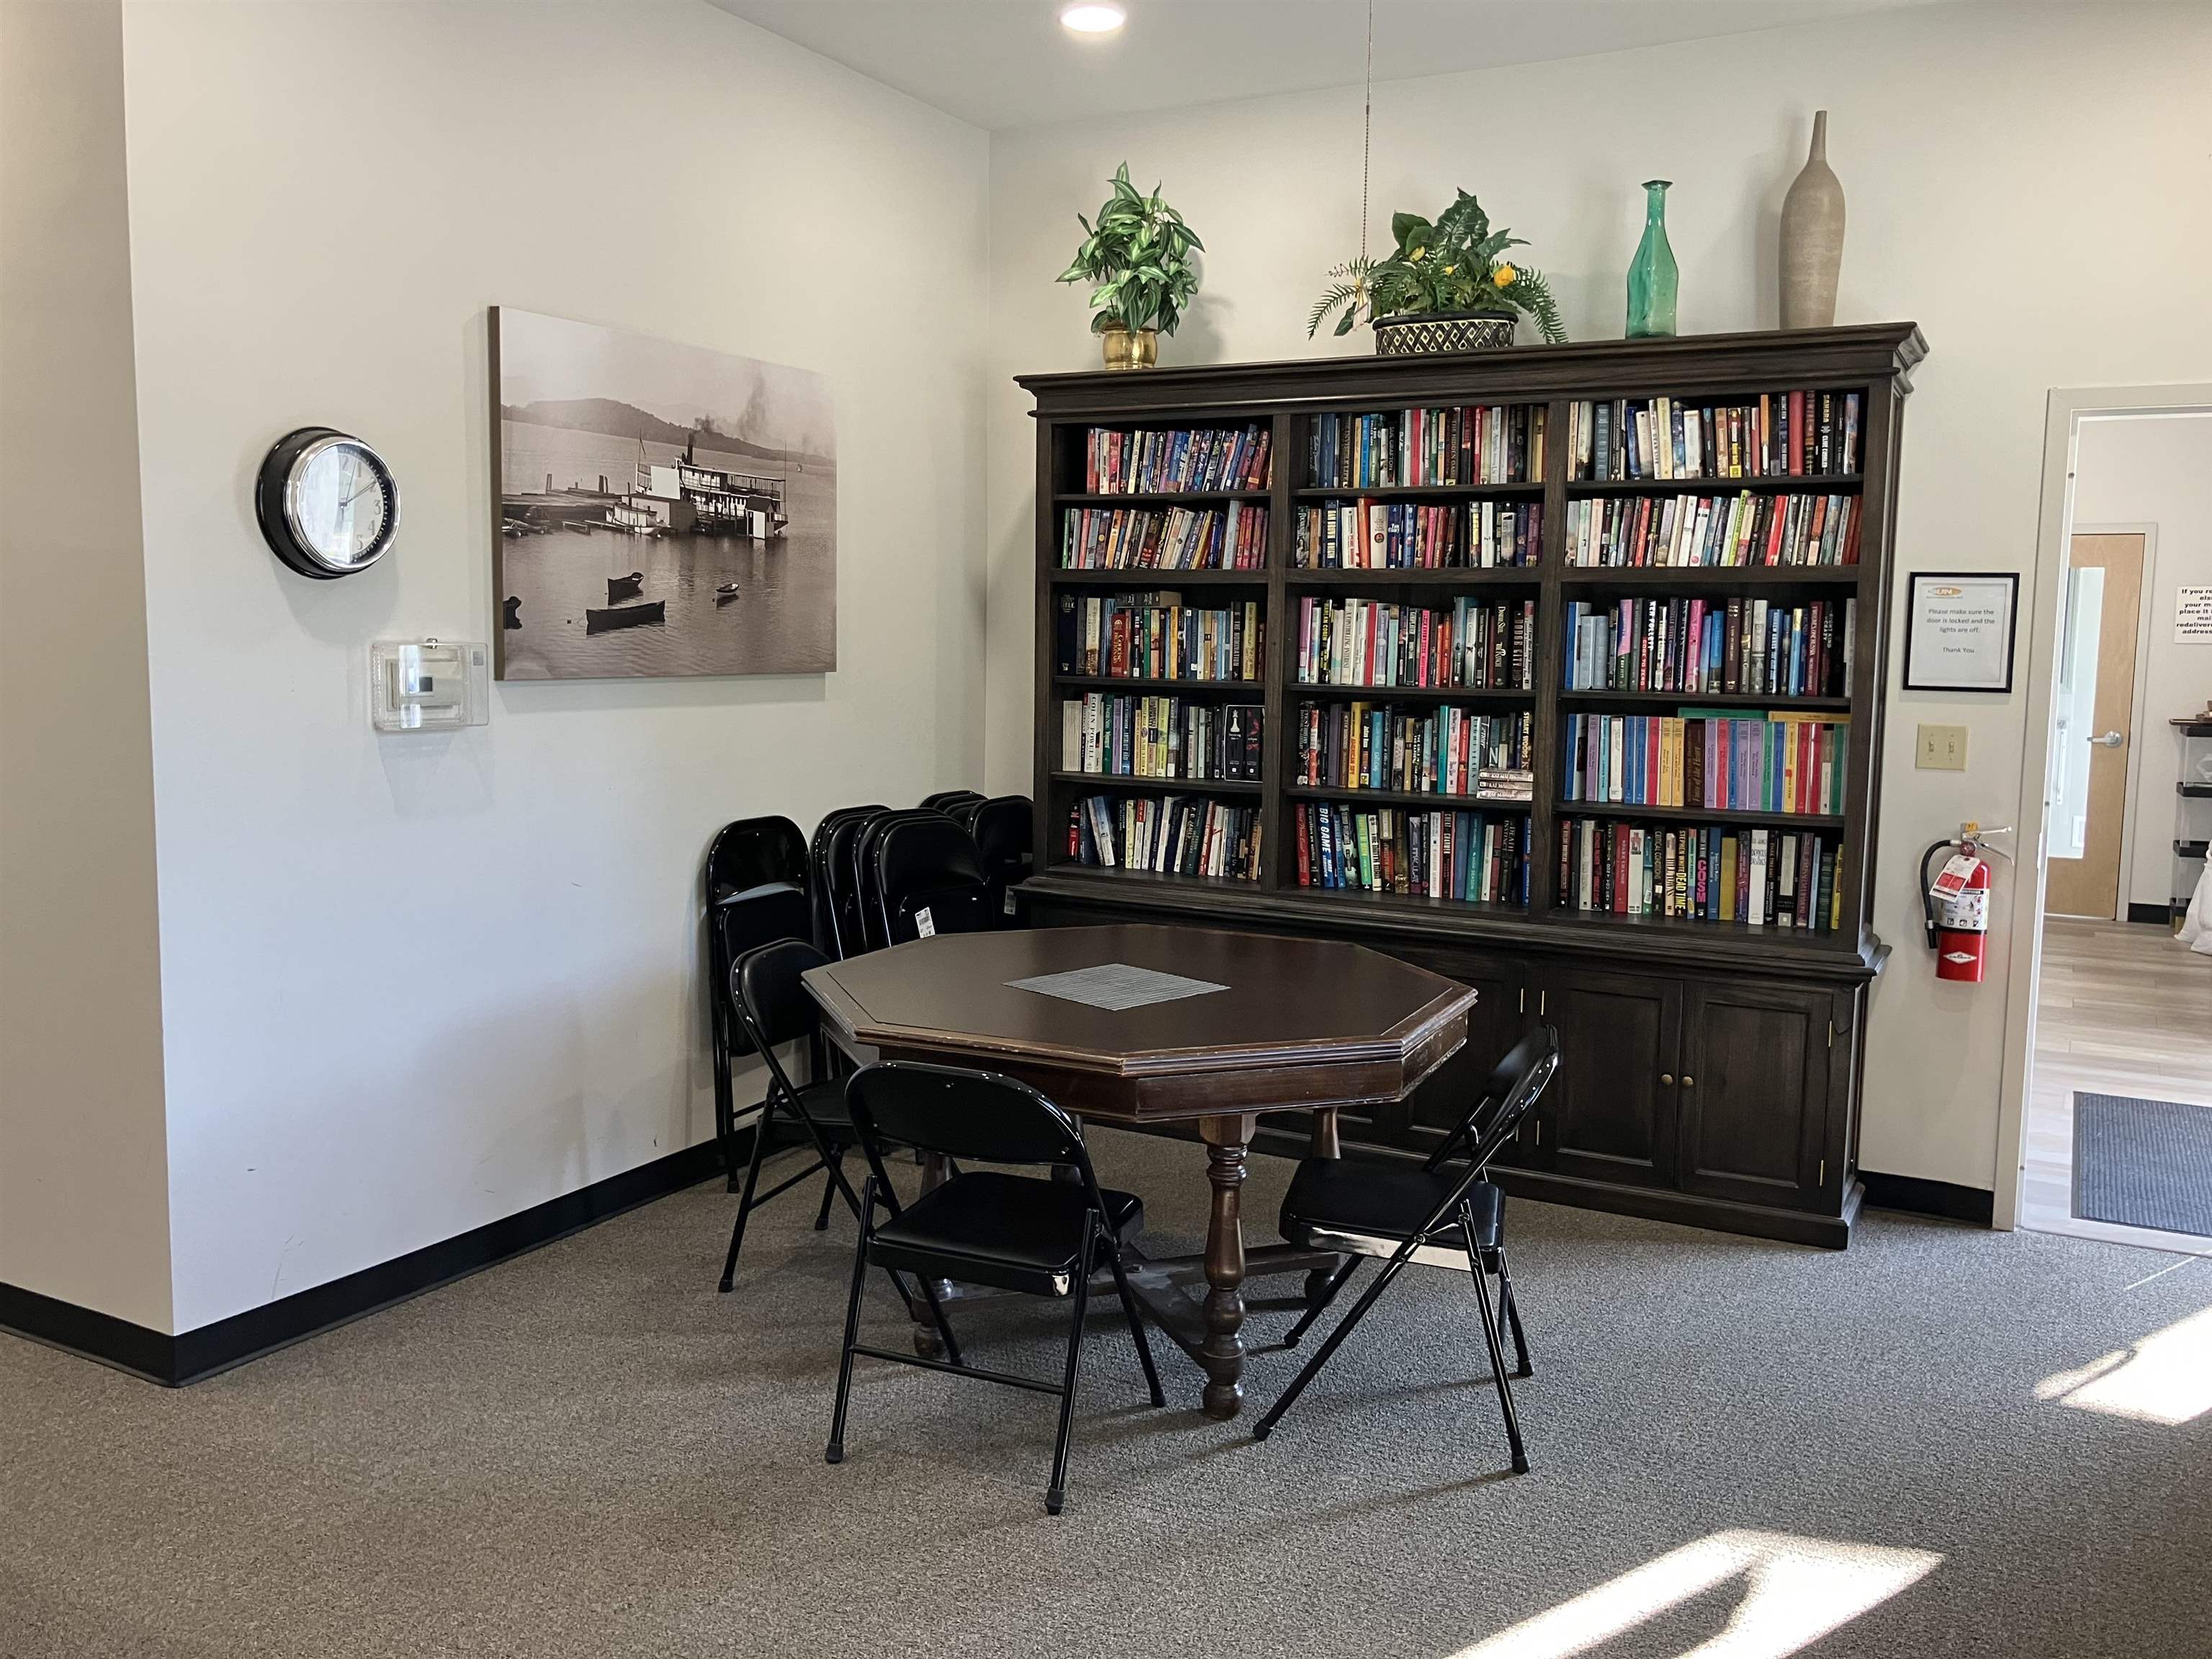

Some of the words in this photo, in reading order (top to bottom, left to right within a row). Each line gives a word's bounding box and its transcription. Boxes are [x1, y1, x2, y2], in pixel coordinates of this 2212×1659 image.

[357, 461, 363, 477] 1
[370, 477, 377, 493] 2
[374, 499, 382, 516] 3
[368, 520, 375, 536] 4
[356, 534, 363, 551] 5
[1514, 619, 1523, 647] DODGE
[1647, 619, 1656, 651] FOLLETT
[1513, 649, 1522, 667] CITY
[1319, 807, 1329, 823] BIG
[1320, 826, 1331, 853] GAME
[1676, 872, 1686, 891] DEAD
[1696, 860, 1707, 902] COSM
[1675, 892, 1686, 909] TIME
